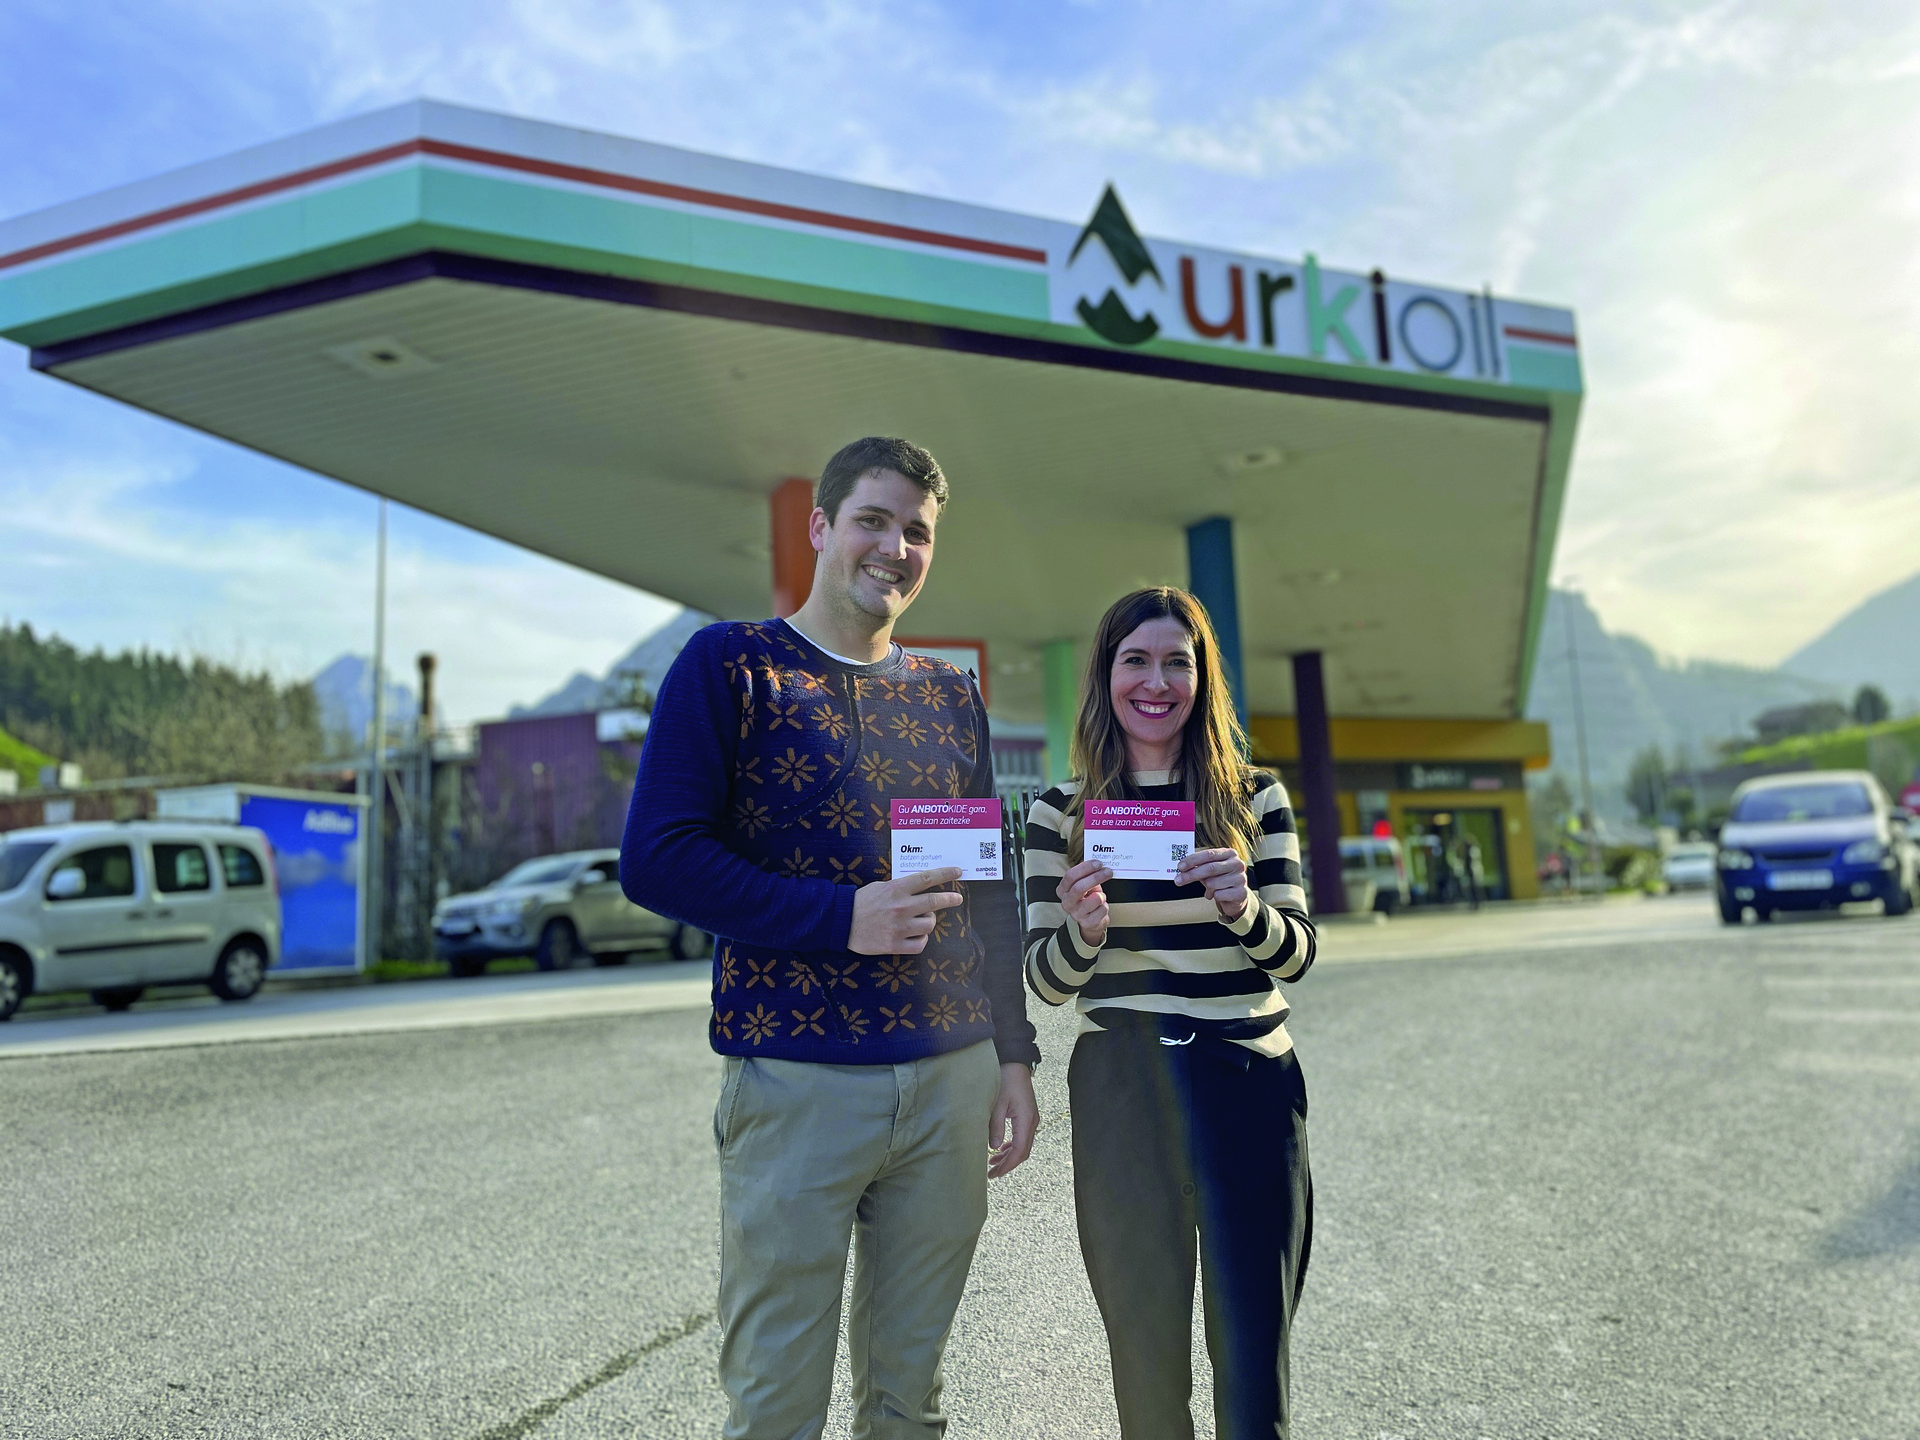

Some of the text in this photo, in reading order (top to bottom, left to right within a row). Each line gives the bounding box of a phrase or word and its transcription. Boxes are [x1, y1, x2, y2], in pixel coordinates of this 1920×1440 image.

[898, 804, 909, 814] Gu
[911, 804, 968, 814] ANBOTOKIDE
[1091, 806, 1102, 815] Gu
[1104, 806, 1161, 816] ANBOTOKIDE
[922, 817, 939, 825] izan
[940, 816, 971, 825] zaitezke
[1115, 818, 1131, 826] izan
[1132, 817, 1163, 827] zaitezke
